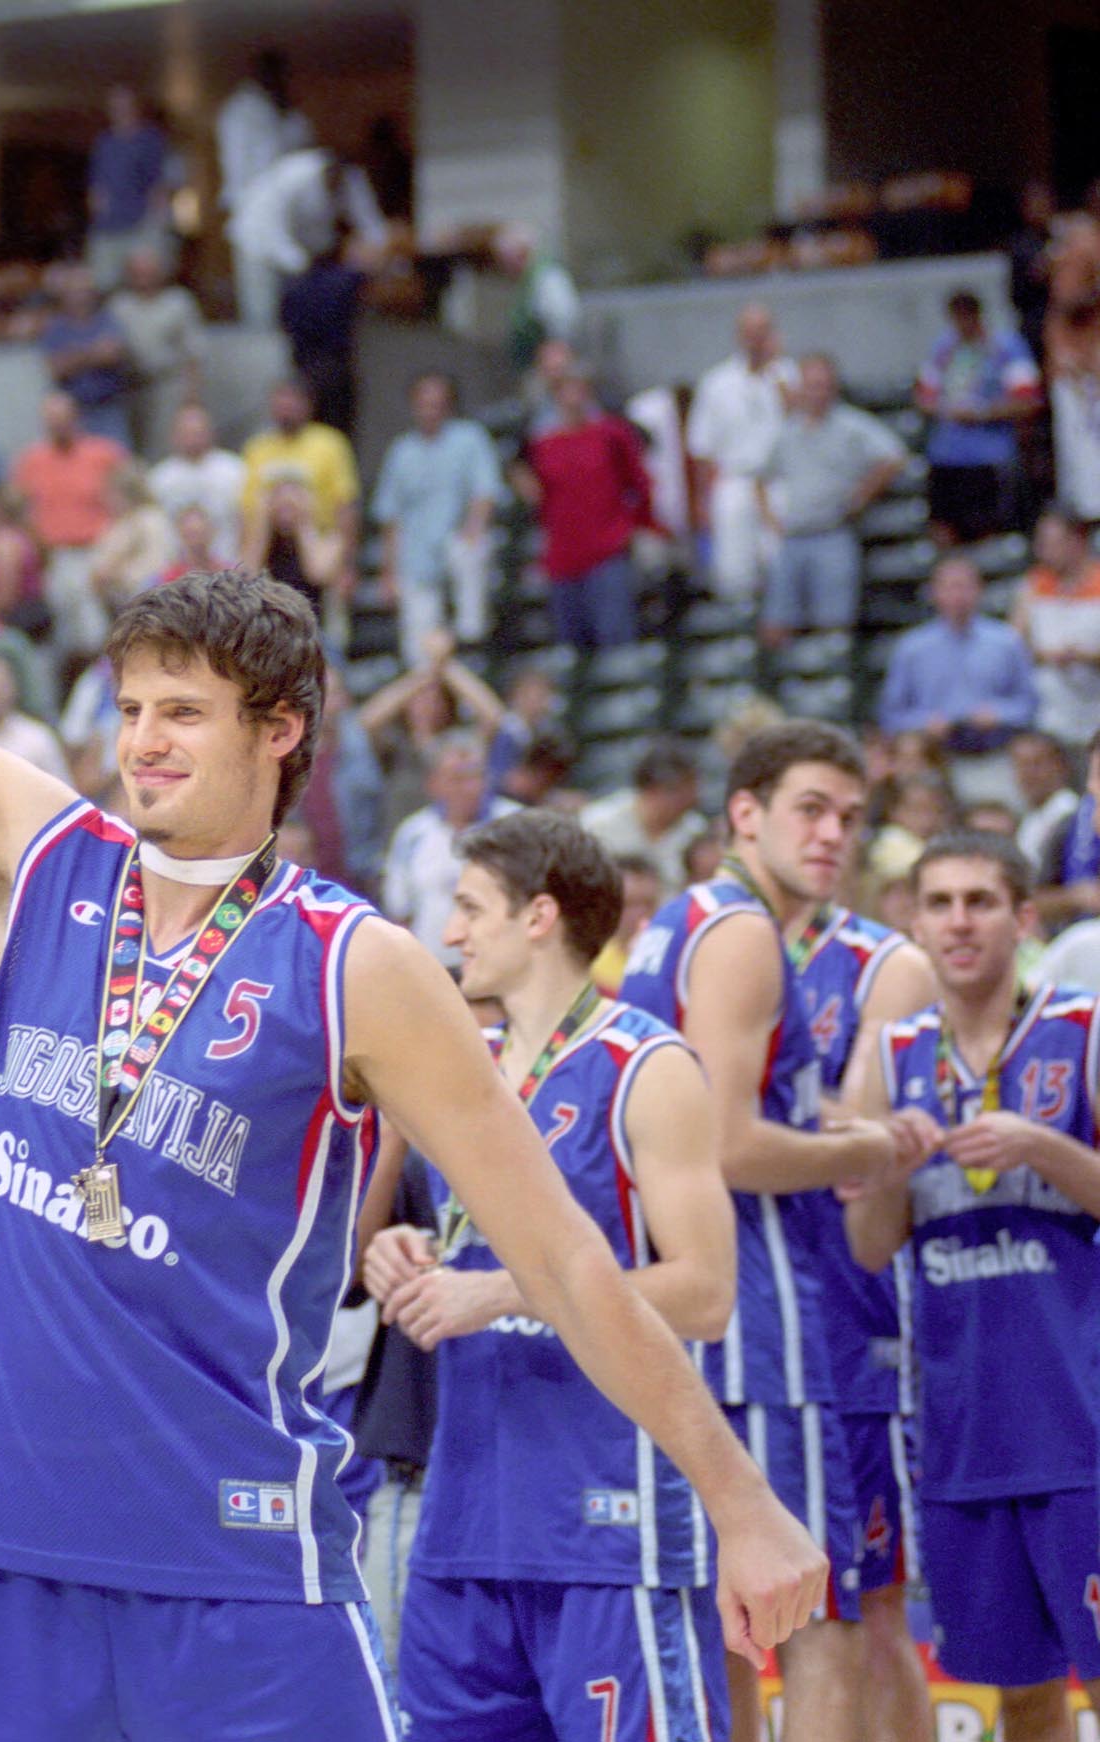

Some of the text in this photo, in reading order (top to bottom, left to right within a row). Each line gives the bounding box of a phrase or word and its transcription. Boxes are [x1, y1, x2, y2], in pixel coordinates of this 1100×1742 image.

[204, 978, 275, 1060] 5
[1020, 1056, 1075, 1119] 13
[586, 1676, 620, 1742] 7
